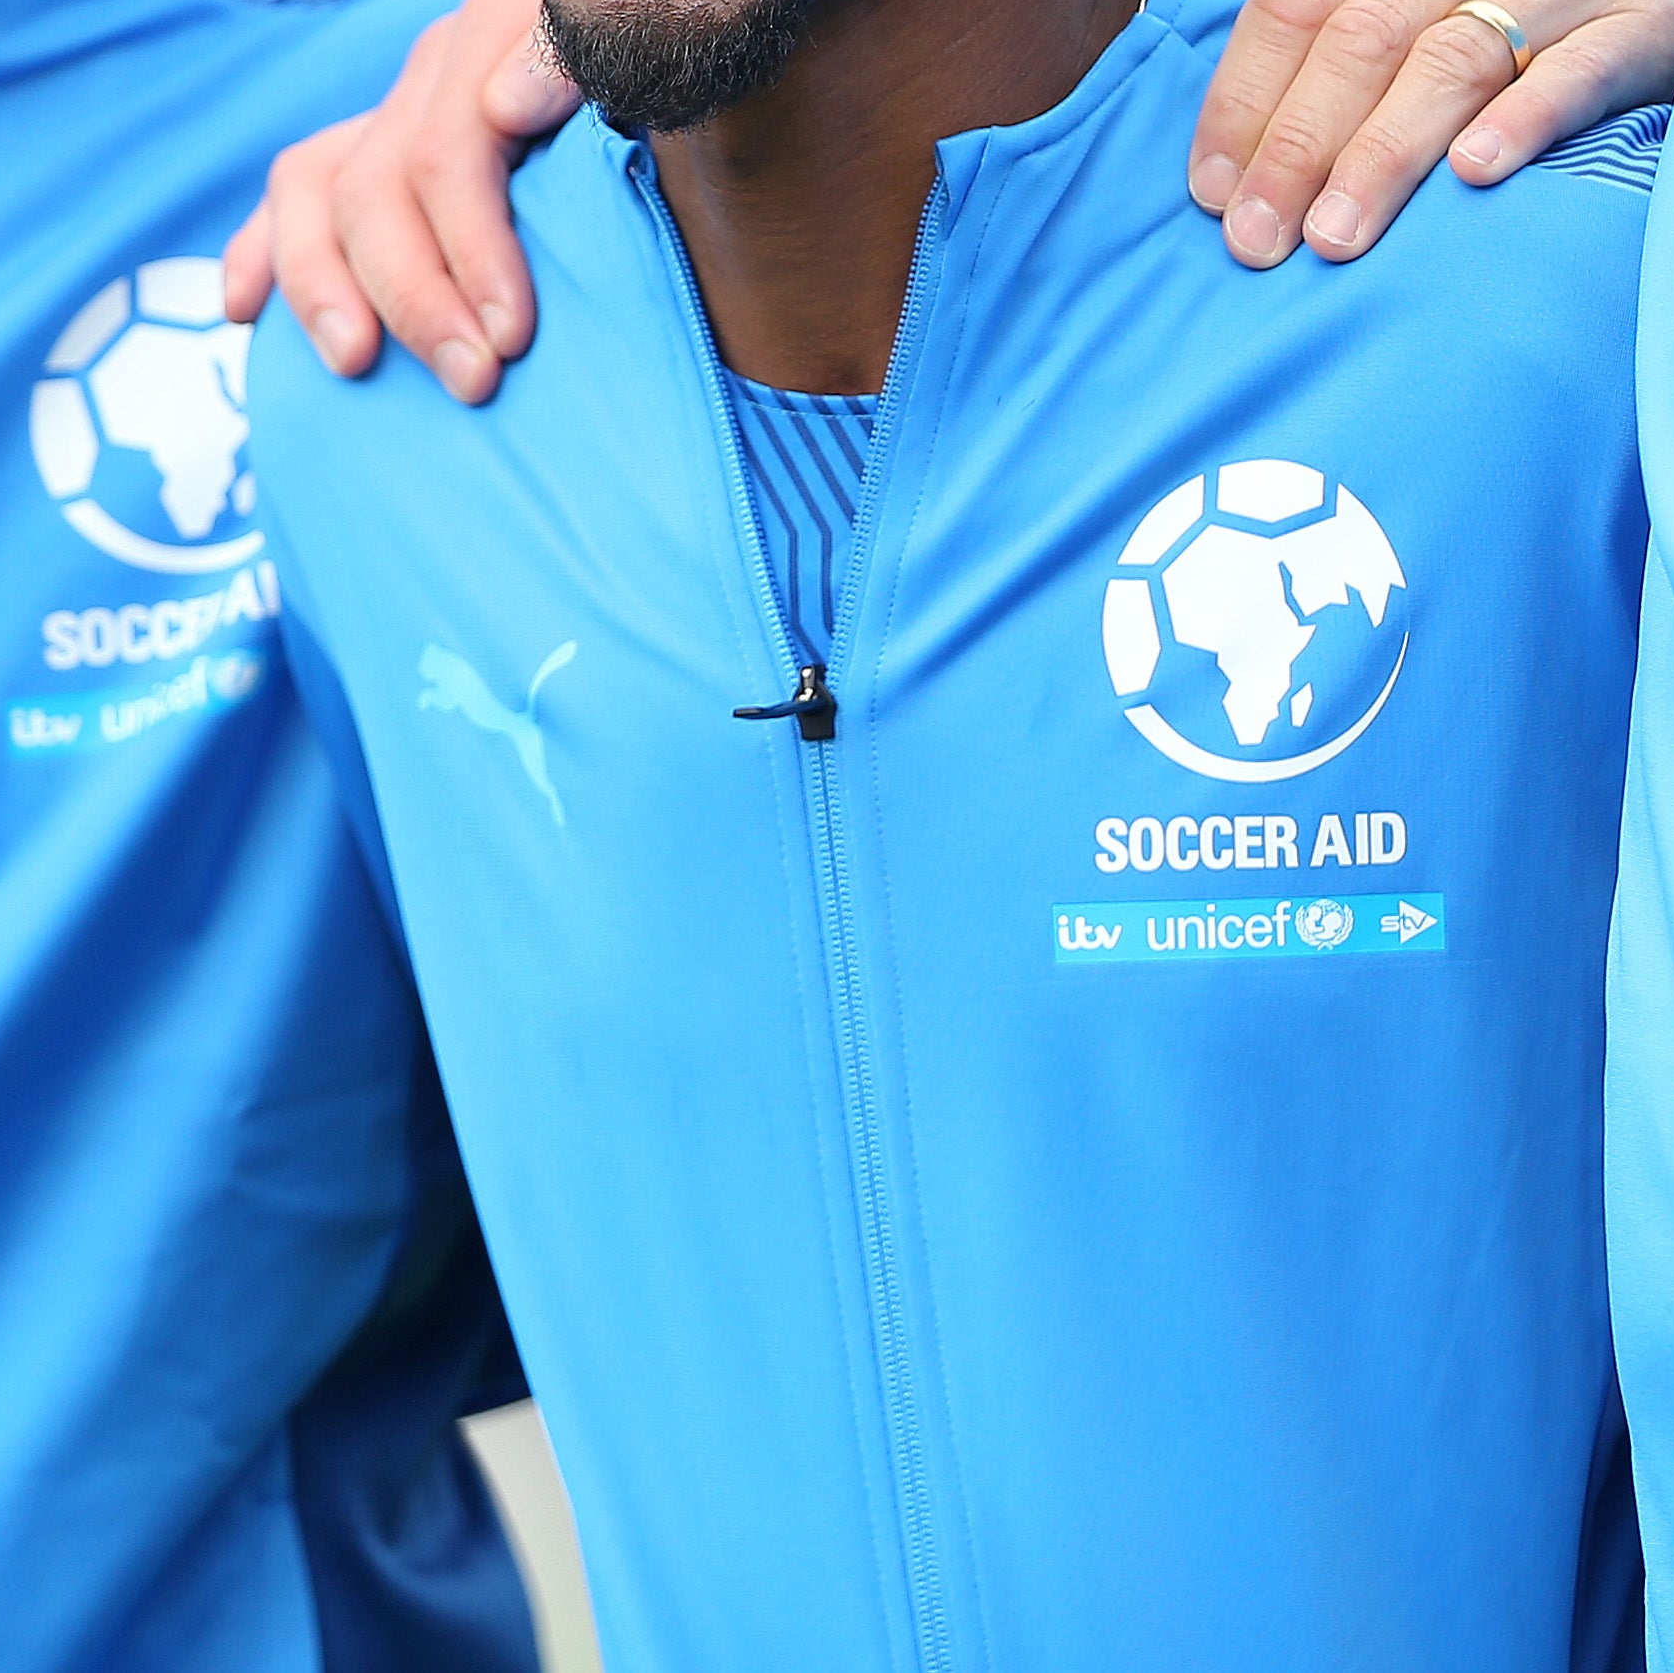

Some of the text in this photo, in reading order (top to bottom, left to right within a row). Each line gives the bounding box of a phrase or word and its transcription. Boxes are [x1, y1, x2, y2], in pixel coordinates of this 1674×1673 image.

[221, 559, 282, 621] AI
[1094, 812, 1407, 874] SOCCER AID
[1057, 914, 1123, 951] itv
[1146, 900, 1293, 951] unicef
